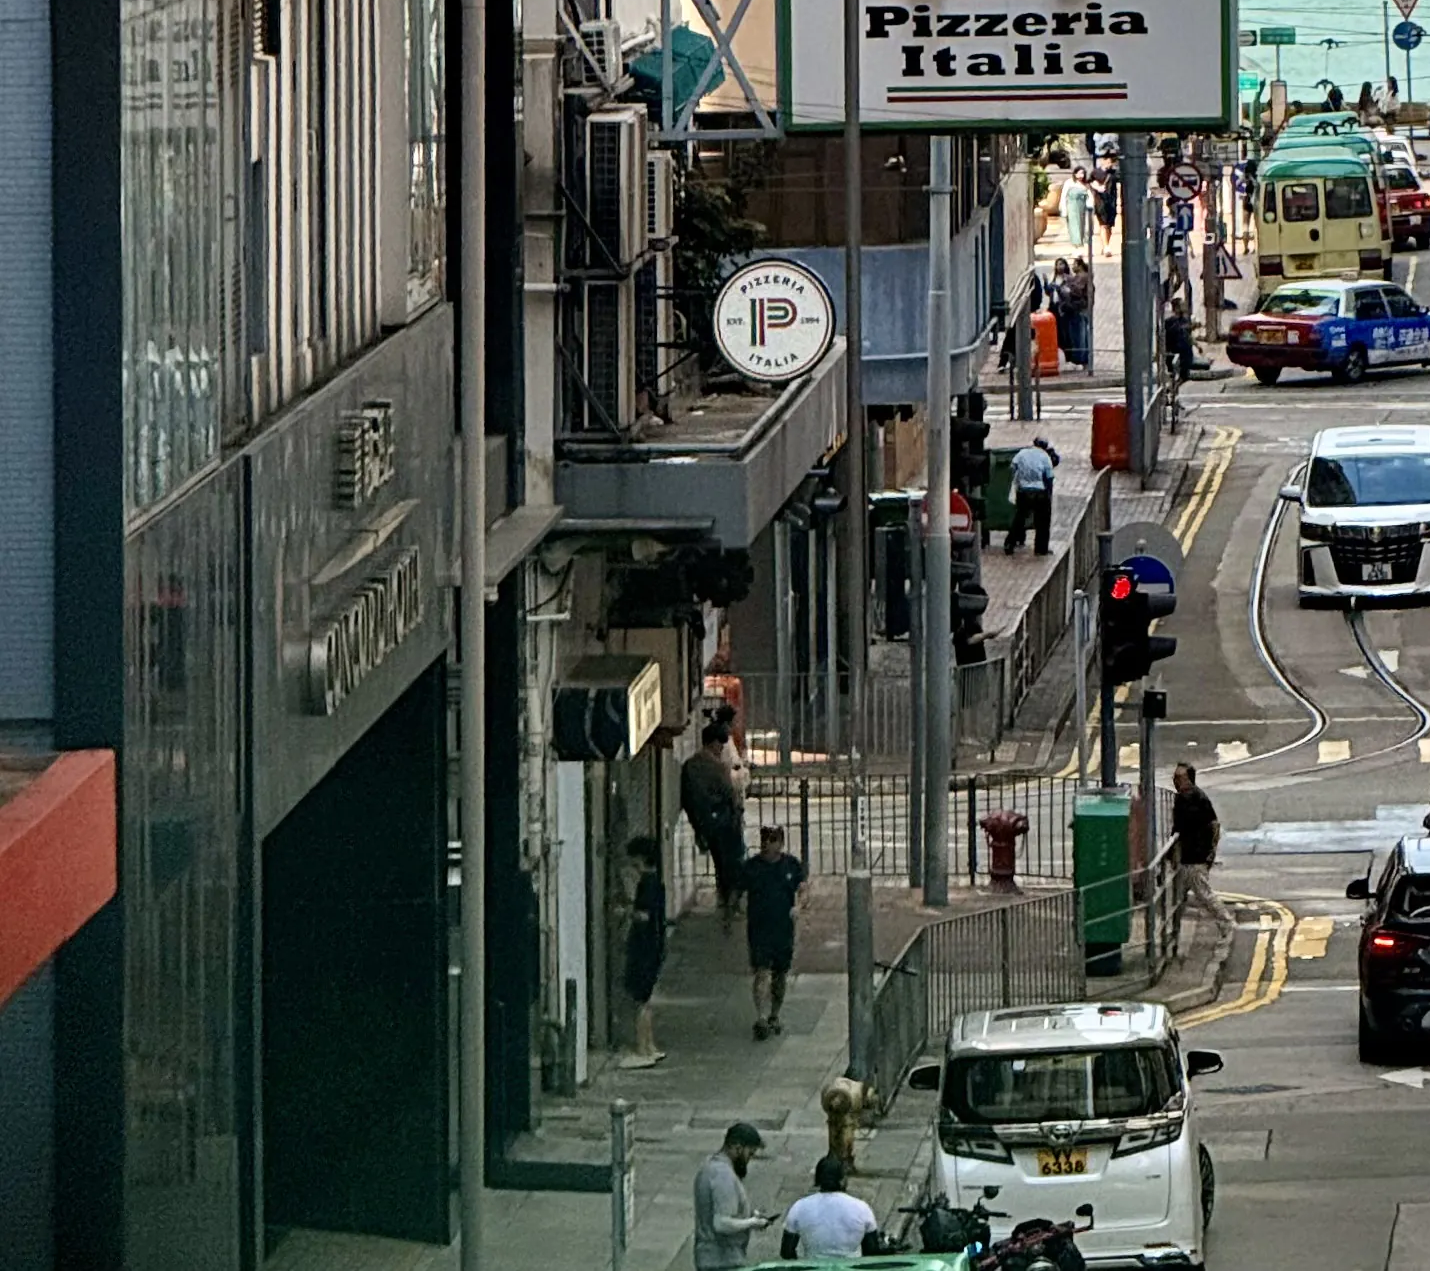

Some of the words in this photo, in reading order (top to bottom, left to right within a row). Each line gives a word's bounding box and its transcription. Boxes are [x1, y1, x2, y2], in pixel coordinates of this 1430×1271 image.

[865, 2, 1148, 39] Pizzeria
[901, 43, 1113, 77] Italia
[740, 275, 805, 295] PIZZERIA
[749, 353, 799, 367] ITALIA
[1042, 1160, 1085, 1175] 6338
